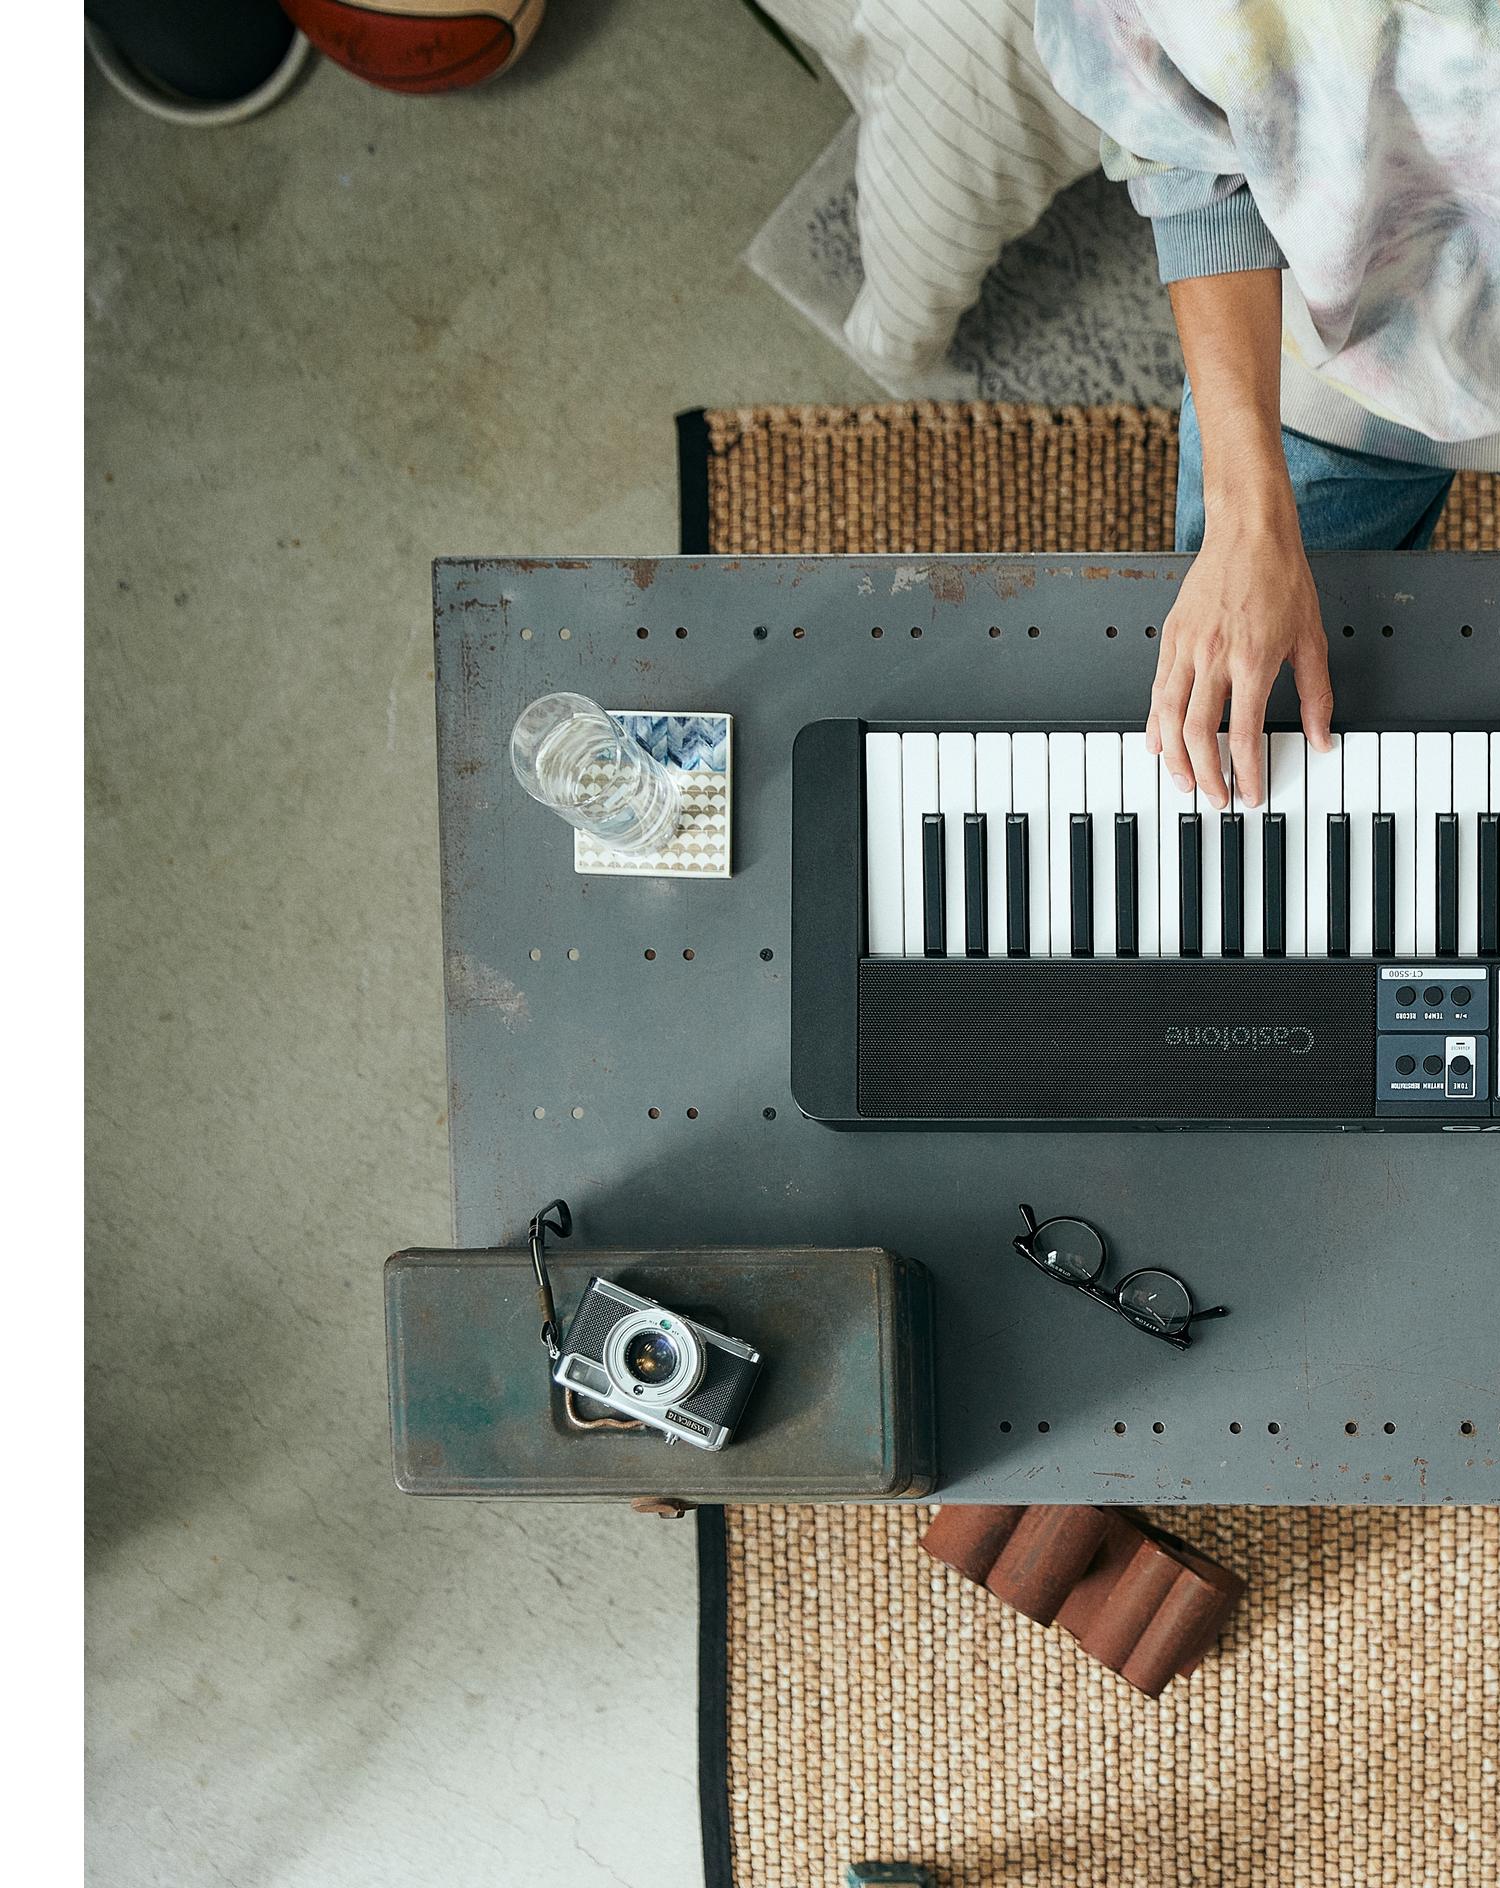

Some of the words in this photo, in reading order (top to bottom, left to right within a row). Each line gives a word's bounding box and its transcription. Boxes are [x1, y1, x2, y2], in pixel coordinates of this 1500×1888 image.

[1388, 970, 1424, 978] CT-S500
[1395, 1012, 1417, 1020] RECORD
[1424, 1012, 1444, 1020] TEMPO
[1166, 1027, 1314, 1053] Casiotone
[1422, 1082, 1444, 1090] RHYTHM
[1453, 1082, 1469, 1090] TONE
[679, 1417, 706, 1434] YASHICA
